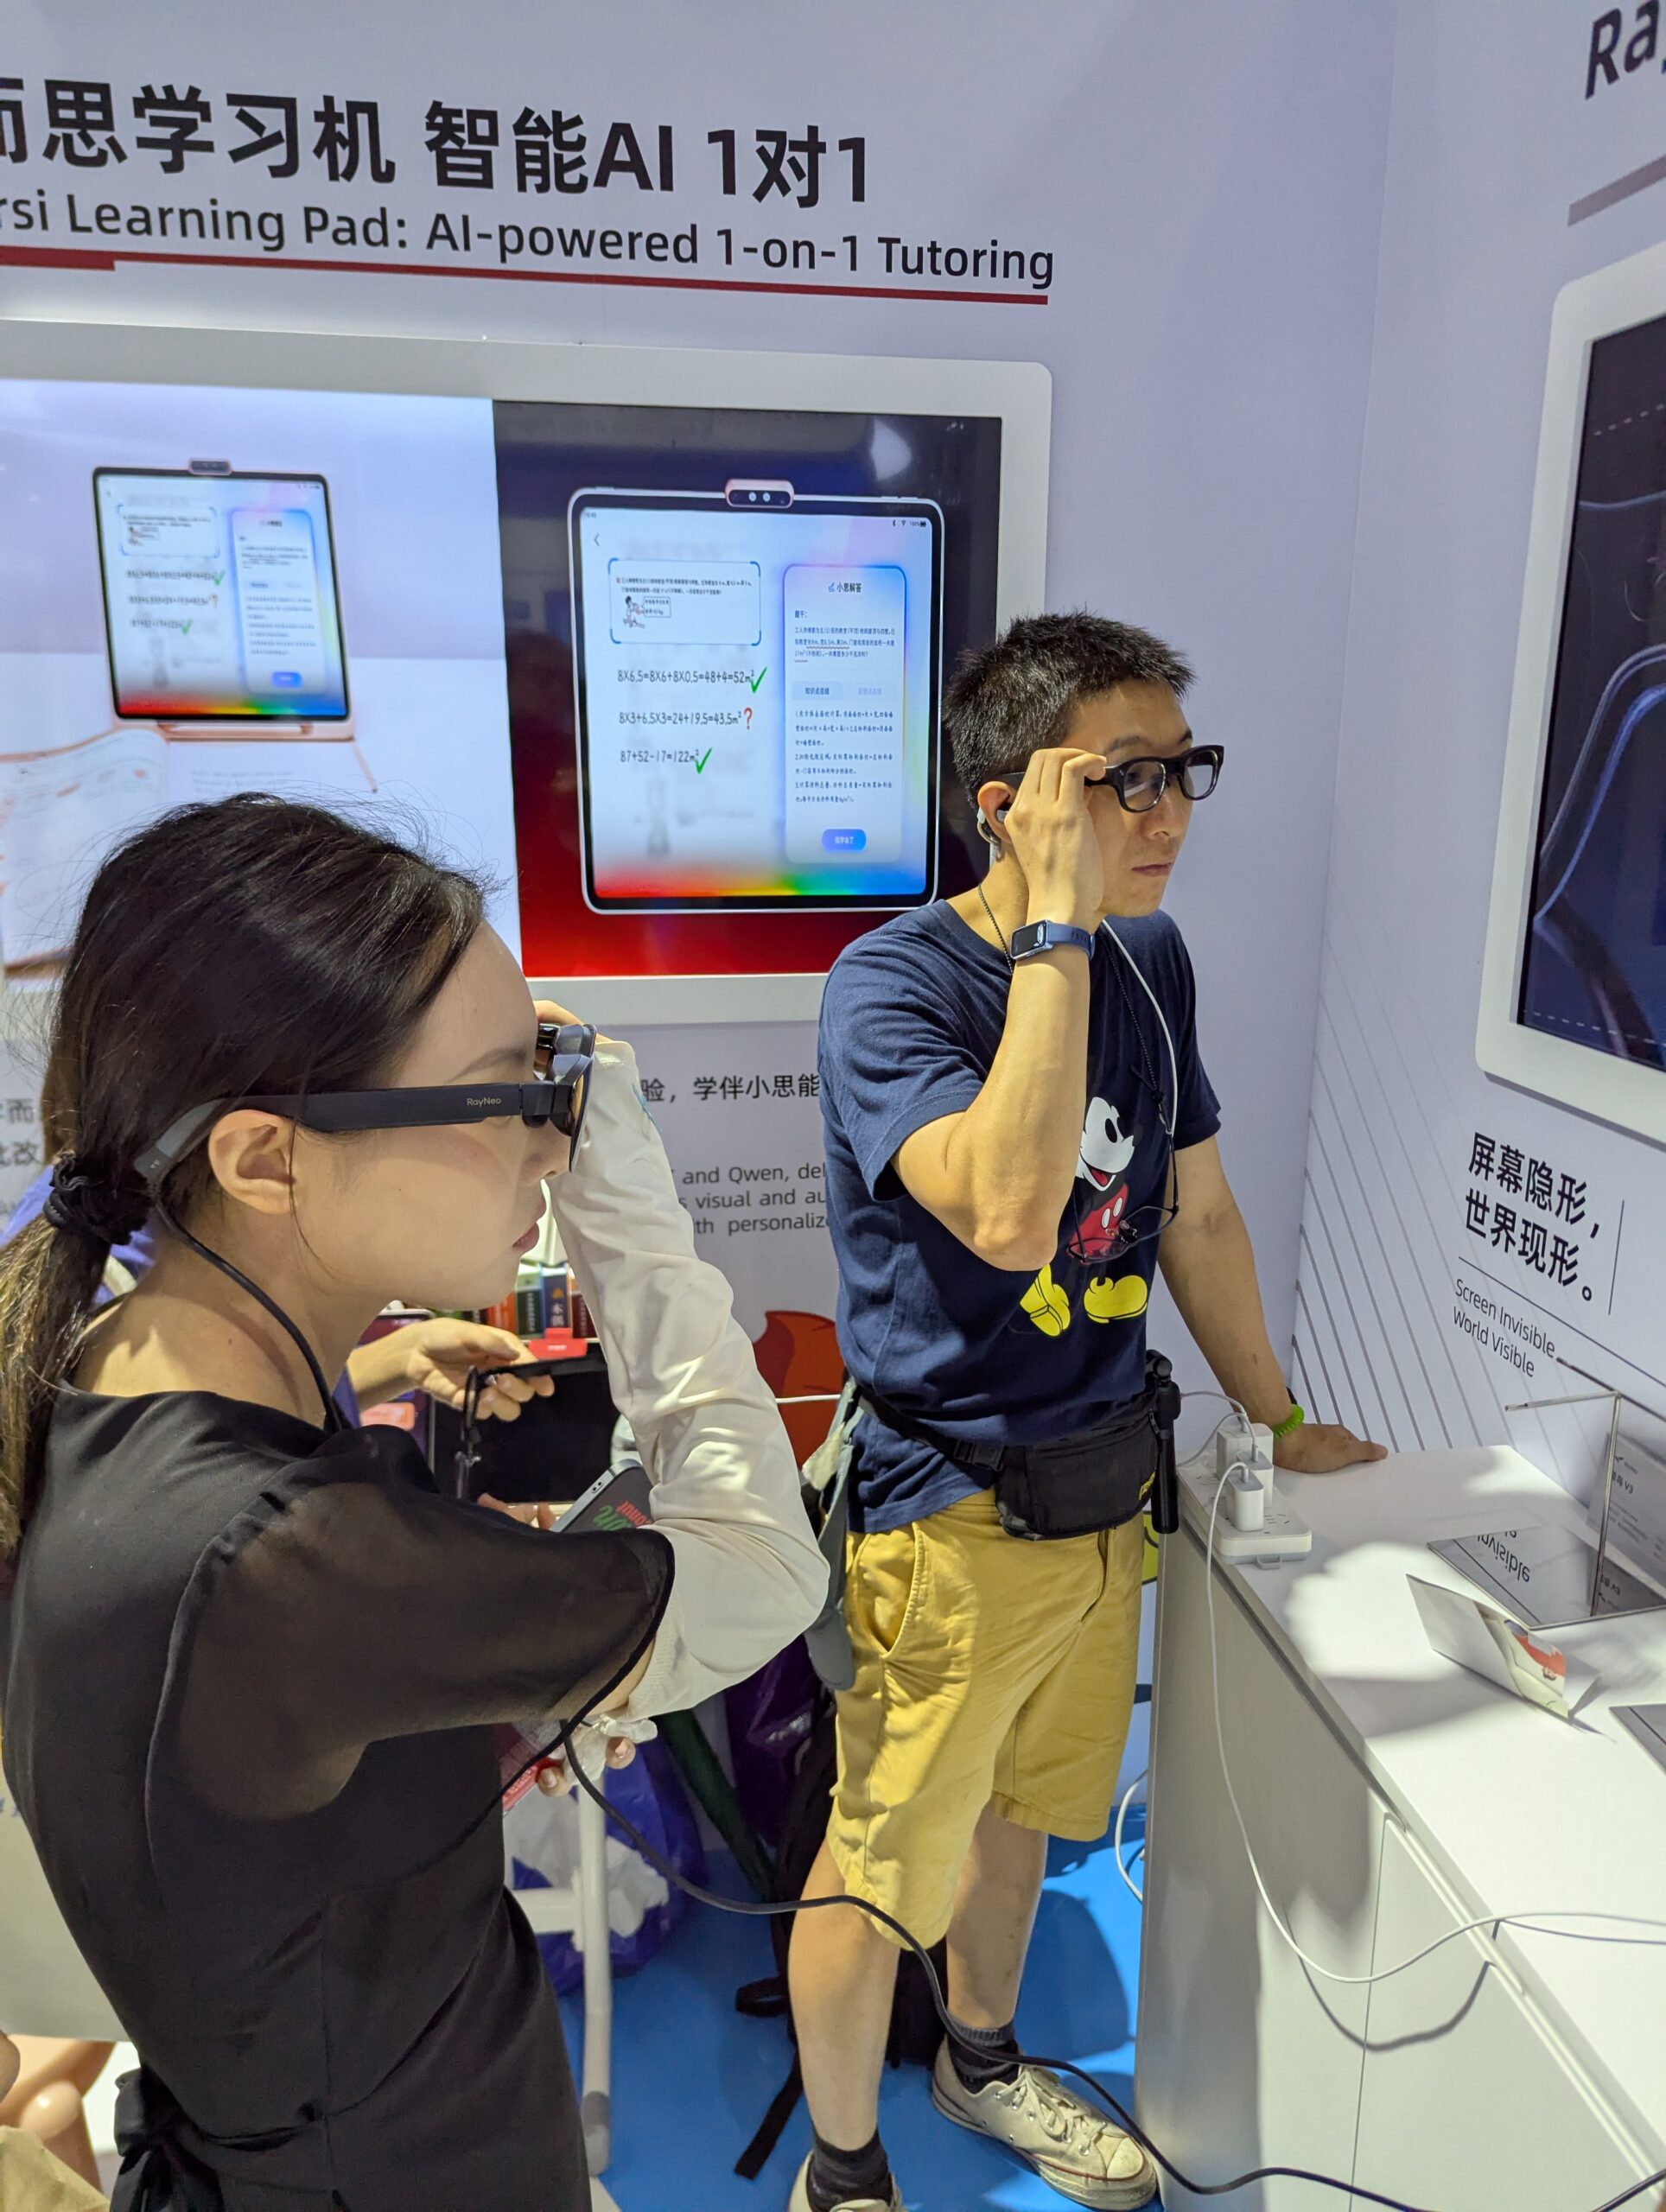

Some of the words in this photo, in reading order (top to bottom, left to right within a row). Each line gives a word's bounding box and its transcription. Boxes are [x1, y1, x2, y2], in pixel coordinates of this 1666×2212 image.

[1585, 0, 1666, 100] Ra
[424, 100, 674, 194] 智能AI
[708, 125, 866, 209] 1对1
[67, 194, 285, 251] Learning
[303, 206, 407, 248] Pad:
[426, 213, 698, 264] AI-powered
[716, 228, 857, 272] 1-on-1
[877, 236, 1053, 289] Tutoring
[467, 1096, 502, 1108] RayNeo
[682, 1166, 720, 1185] and
[728, 1166, 790, 1185] Qwen,
[695, 1191, 751, 1209] visual
[760, 1189, 795, 1206] and
[728, 1212, 829, 1236] personaliz
[1453, 1306, 1489, 1346] World
[1491, 1332, 1535, 1378] Visible
[1455, 1278, 1497, 1320] Screen
[1499, 1306, 1555, 1358] Invisible
